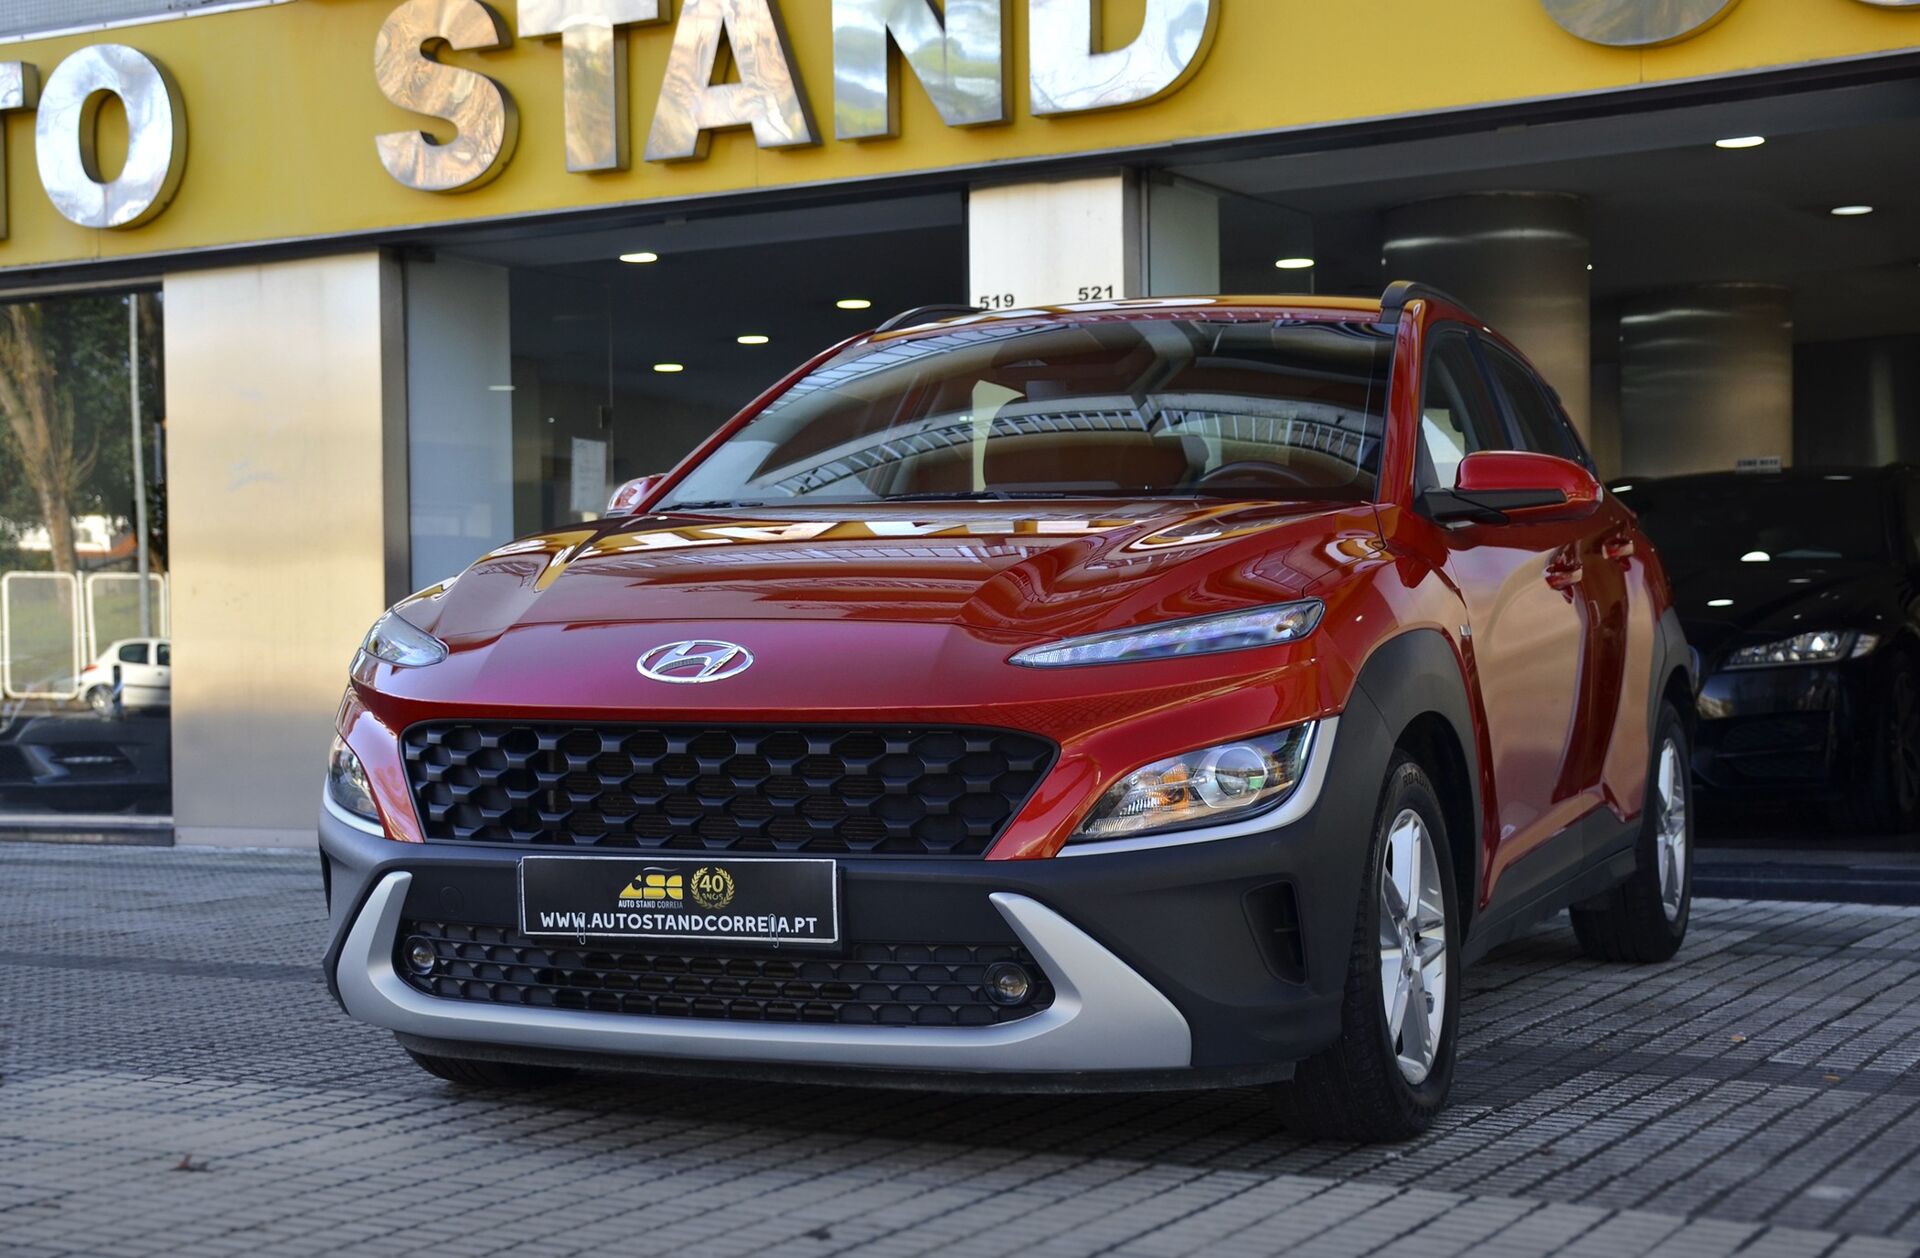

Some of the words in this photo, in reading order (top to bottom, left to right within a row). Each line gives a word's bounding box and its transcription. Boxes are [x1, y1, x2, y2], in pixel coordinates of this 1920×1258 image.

[0, 44, 187, 240] O
[374, 0, 1219, 193] STAND
[979, 293, 1015, 310] 519
[1078, 285, 1113, 301] 521
[699, 874, 724, 893] 40
[618, 900, 635, 909] AUTO
[636, 900, 656, 909] STAND
[656, 900, 684, 909] CORREIA
[540, 911, 818, 934] WWW.AUTOSTANDCORREIA.PT
